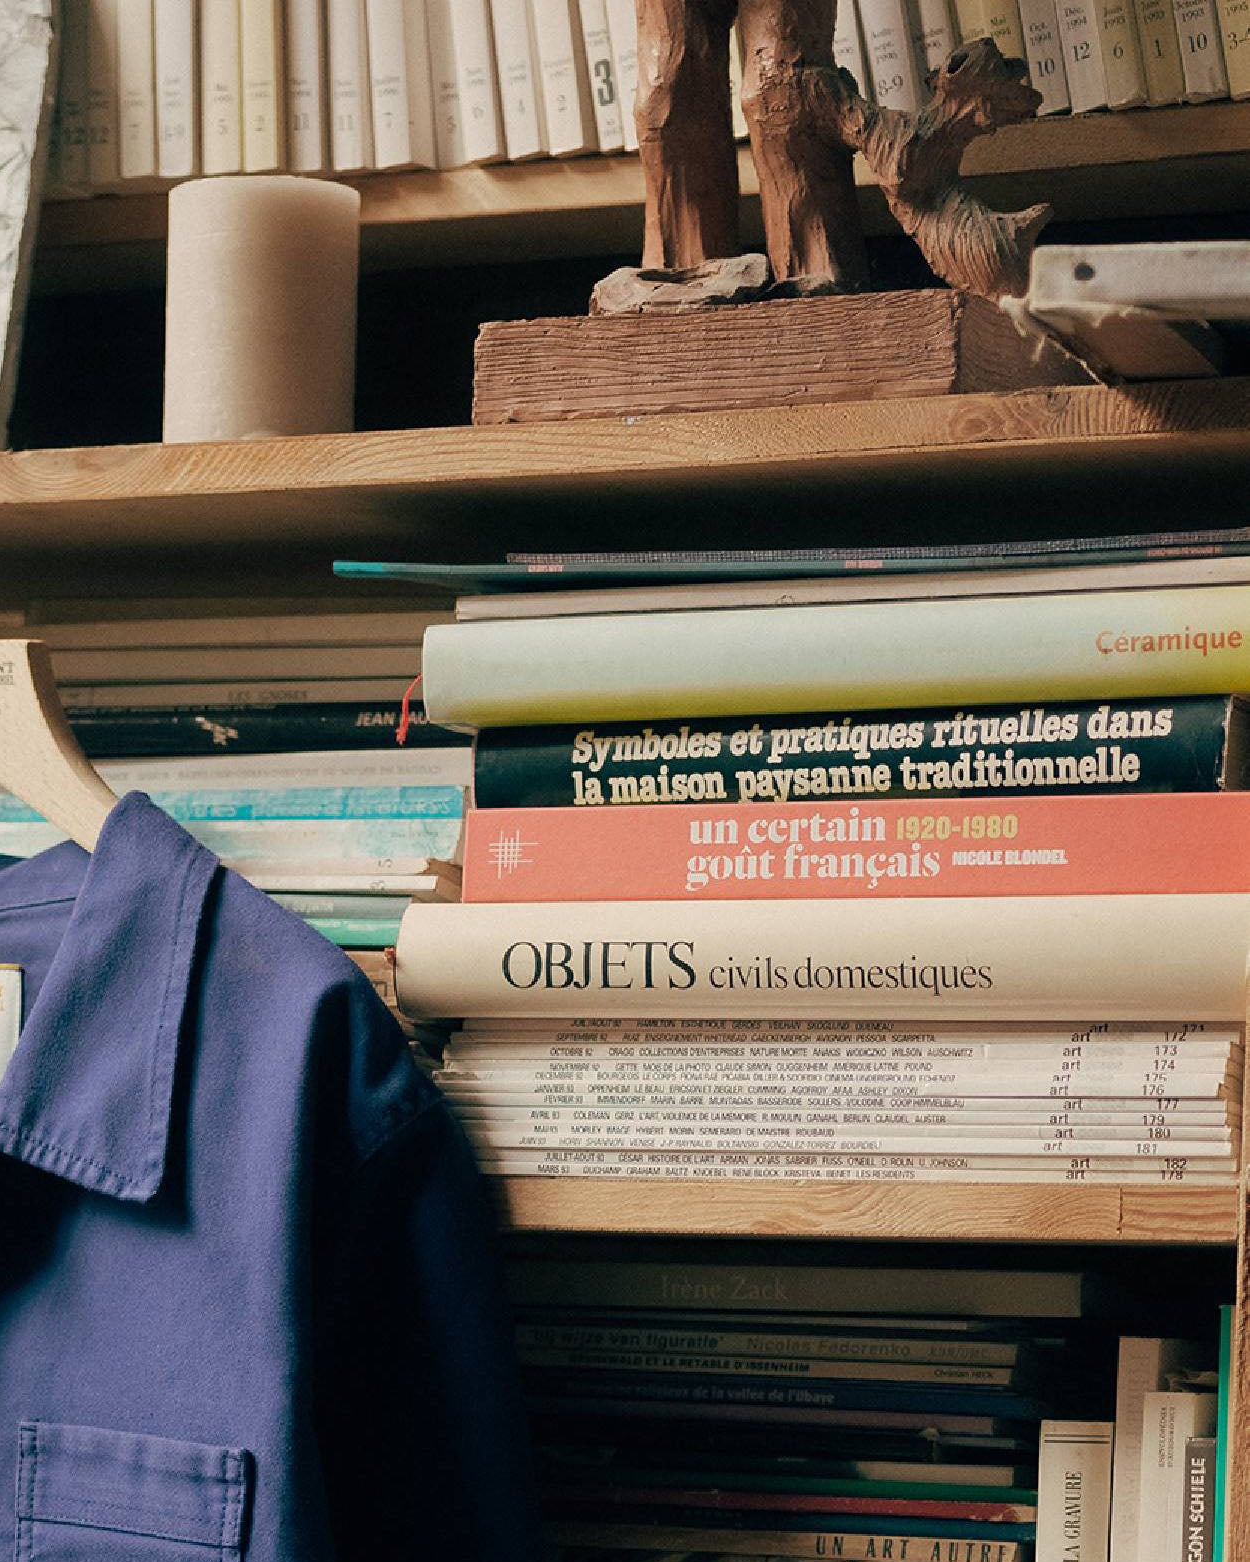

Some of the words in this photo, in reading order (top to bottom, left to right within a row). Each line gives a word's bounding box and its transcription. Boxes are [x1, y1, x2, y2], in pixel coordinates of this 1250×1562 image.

[1073, 41, 1091, 62] 12
[1113, 44, 1124, 59] 6
[1154, 38, 1165, 59] 1
[1188, 31, 1208, 53] 10
[1037, 57, 1055, 77] 10
[594, 58, 616, 107] 3
[1096, 624, 1244, 656] Céramique
[355, 711, 397, 727] JEAN
[571, 726, 723, 773] Symboles
[729, 726, 763, 758] et
[766, 718, 924, 764] pratiques
[932, 708, 1079, 750] rituelles
[1086, 705, 1174, 742] dans
[572, 771, 603, 806] la
[609, 767, 727, 804] maison
[736, 760, 892, 805] paysanne
[899, 746, 1141, 792] traditionnelle
[689, 816, 739, 845] un
[748, 807, 886, 844] certain
[896, 815, 1018, 841] 1920-1980
[686, 847, 775, 892] goût
[784, 842, 941, 889] français
[952, 849, 1003, 866] NICOLE
[1004, 848, 1069, 866] BLONDEL
[501, 941, 697, 990] OBJETS
[709, 956, 788, 990] civils
[794, 955, 994, 997] domestiques
[1071, 1032, 1090, 1042] art
[1062, 1046, 1082, 1056] art
[1155, 1045, 1178, 1056] 173
[1061, 1060, 1081, 1070] art
[1154, 1059, 1175, 1070] 174
[1049, 1085, 1069, 1096] art
[1142, 1084, 1165, 1096] 176
[1062, 1099, 1083, 1110] art
[1157, 1098, 1180, 1110] 177
[1049, 1113, 1069, 1124] art
[1142, 1115, 1165, 1126] 179
[1054, 1127, 1074, 1138] art
[1148, 1127, 1171, 1139] 180
[1042, 1141, 1062, 1151] art
[1136, 1143, 1158, 1154] 181
[1070, 1157, 1090, 1169] art
[1164, 1158, 1188, 1169] 182
[1065, 1170, 1086, 1180] art
[731, 1276, 790, 1300] Zack
[747, 1336, 811, 1355] Nicolas
[816, 1339, 912, 1358] Fedorenko
[1189, 1457, 1207, 1524] SCHIELE
[1063, 1470, 1083, 1540] GRAVURE
[816, 1535, 844, 1556] UN
[865, 1536, 910, 1560] ART
